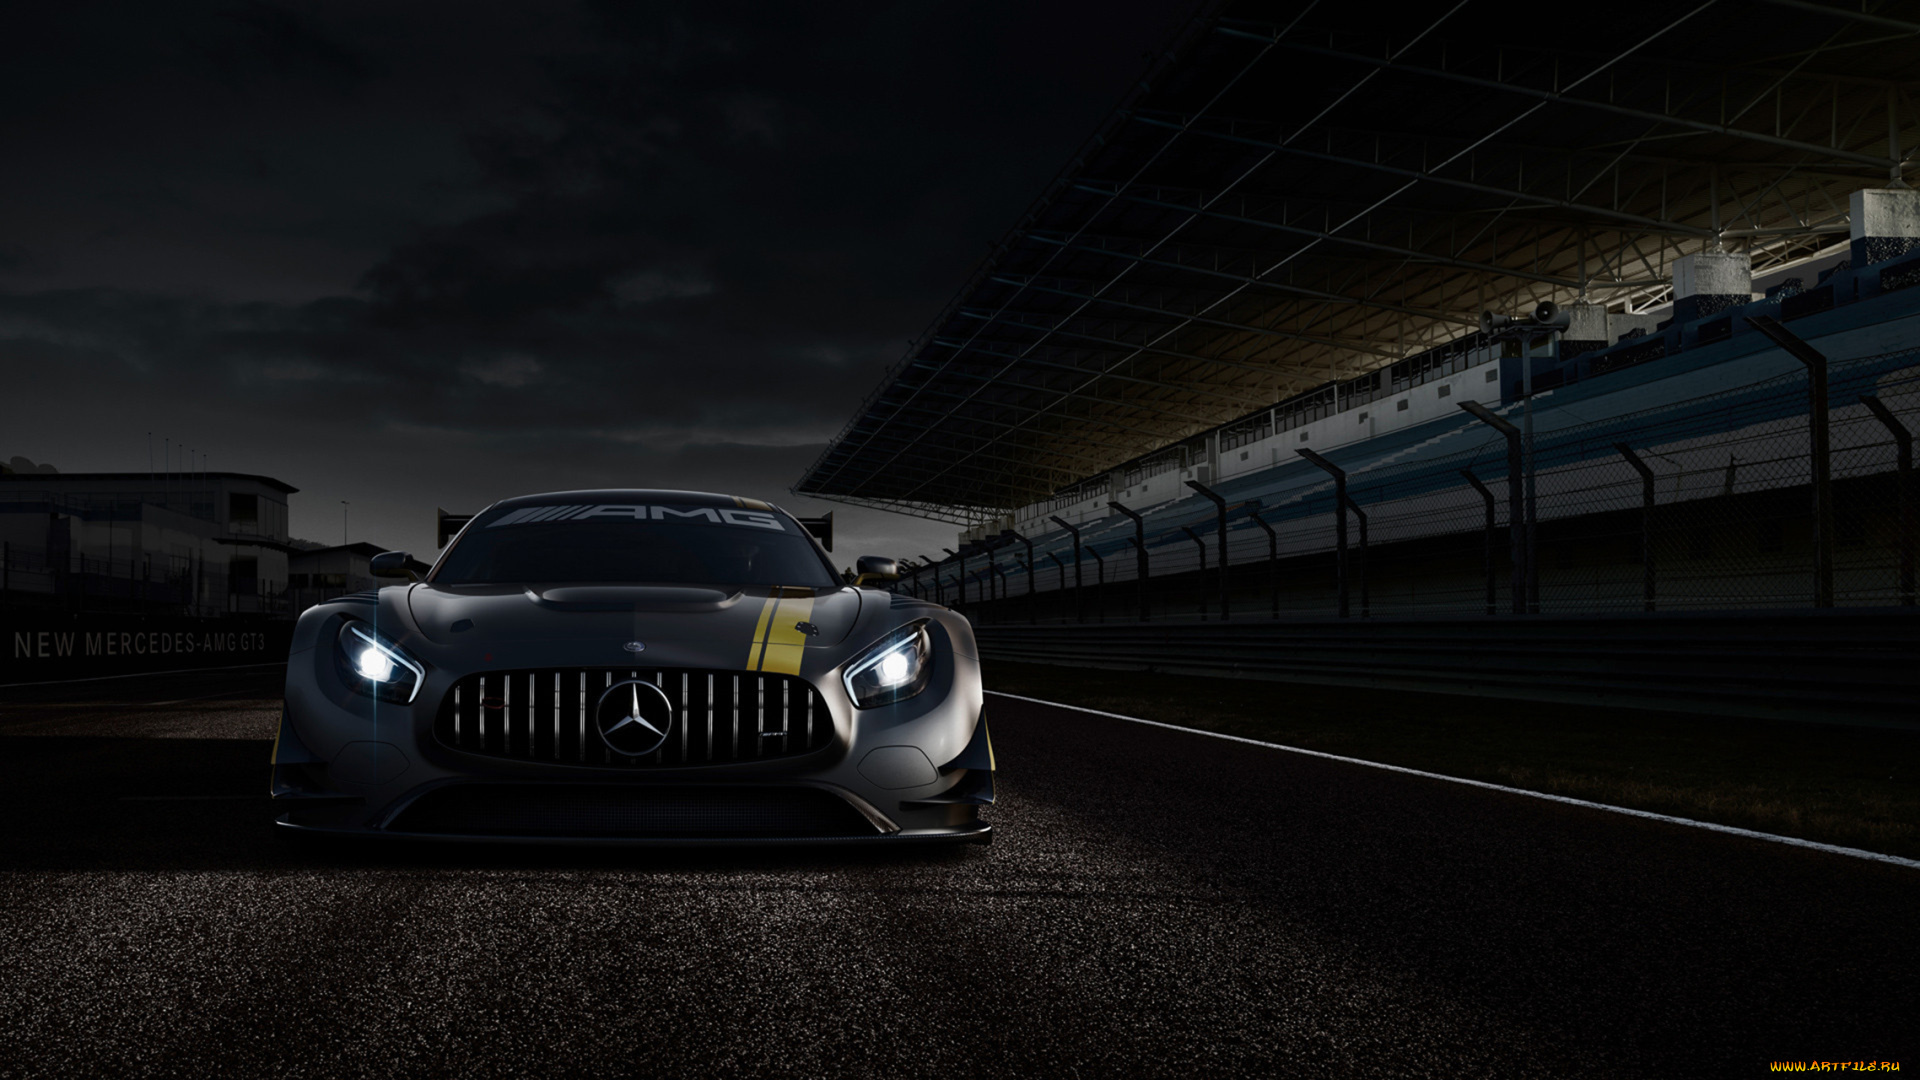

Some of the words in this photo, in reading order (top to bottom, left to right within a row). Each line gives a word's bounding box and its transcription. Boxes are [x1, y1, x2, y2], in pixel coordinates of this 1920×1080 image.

[567, 504, 786, 531] AMG
[14, 631, 76, 659] NEW
[85, 631, 237, 656] MERCEDES-AMG
[240, 632, 265, 651] GT3
